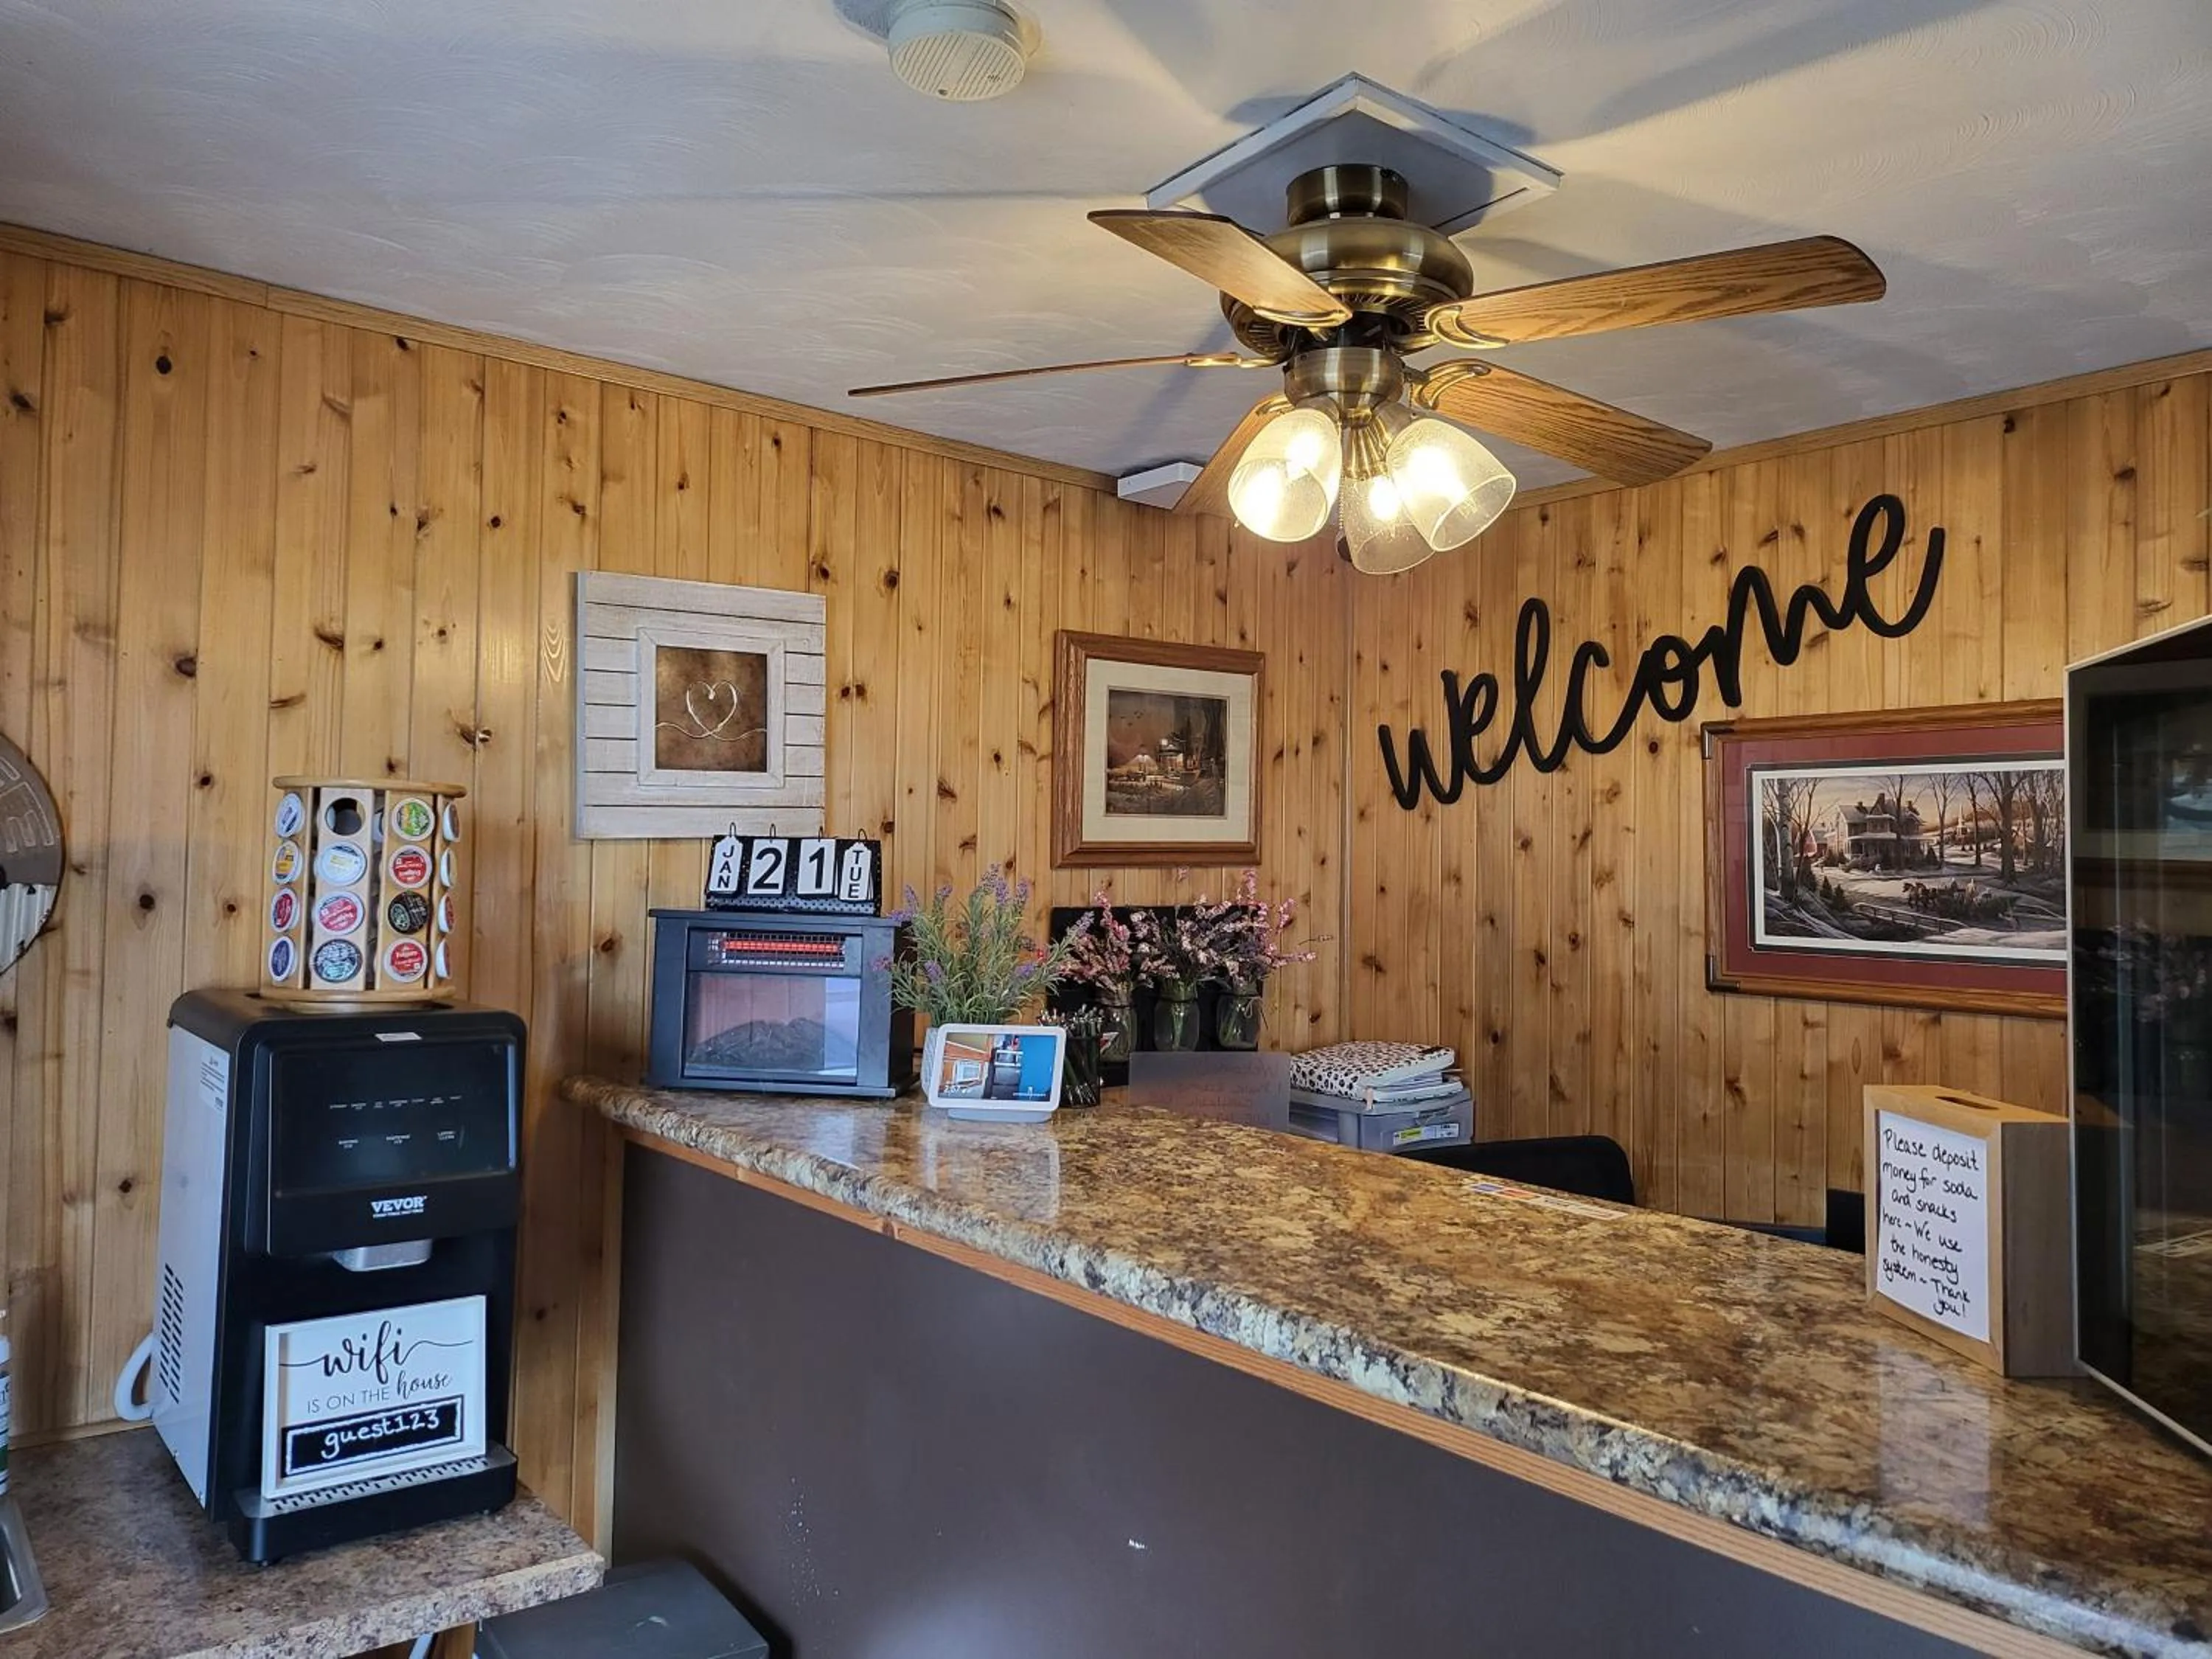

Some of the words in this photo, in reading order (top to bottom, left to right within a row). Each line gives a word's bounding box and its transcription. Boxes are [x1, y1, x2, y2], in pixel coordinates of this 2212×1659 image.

[1378, 493, 1945, 810] welcome
[717, 844, 735, 888] JAN
[849, 850, 865, 899] TUE
[1882, 1129, 1927, 1158] Please
[1933, 1144, 1979, 1171] deposit
[371, 1196, 425, 1214] VEVOR
[1919, 1167, 1936, 1189] for
[1943, 1180, 1978, 1200] soda
[1882, 1206, 1902, 1228] here
[1914, 1220, 1931, 1241] We
[1938, 1234, 1963, 1253] use
[1916, 1199, 1957, 1222] snacks
[1882, 1258, 1916, 1282] system
[1930, 1278, 1970, 1303] Thank
[1891, 1234, 1906, 1255] the
[1912, 1244, 1959, 1285] honesty
[1933, 1299, 1966, 1318] you!
[322, 1321, 410, 1385] wifi
[307, 1398, 321, 1414] IS
[327, 1394, 355, 1411] ON
[362, 1386, 391, 1403] THE
[397, 1369, 451, 1399] house
[321, 1408, 440, 1460] guest123
